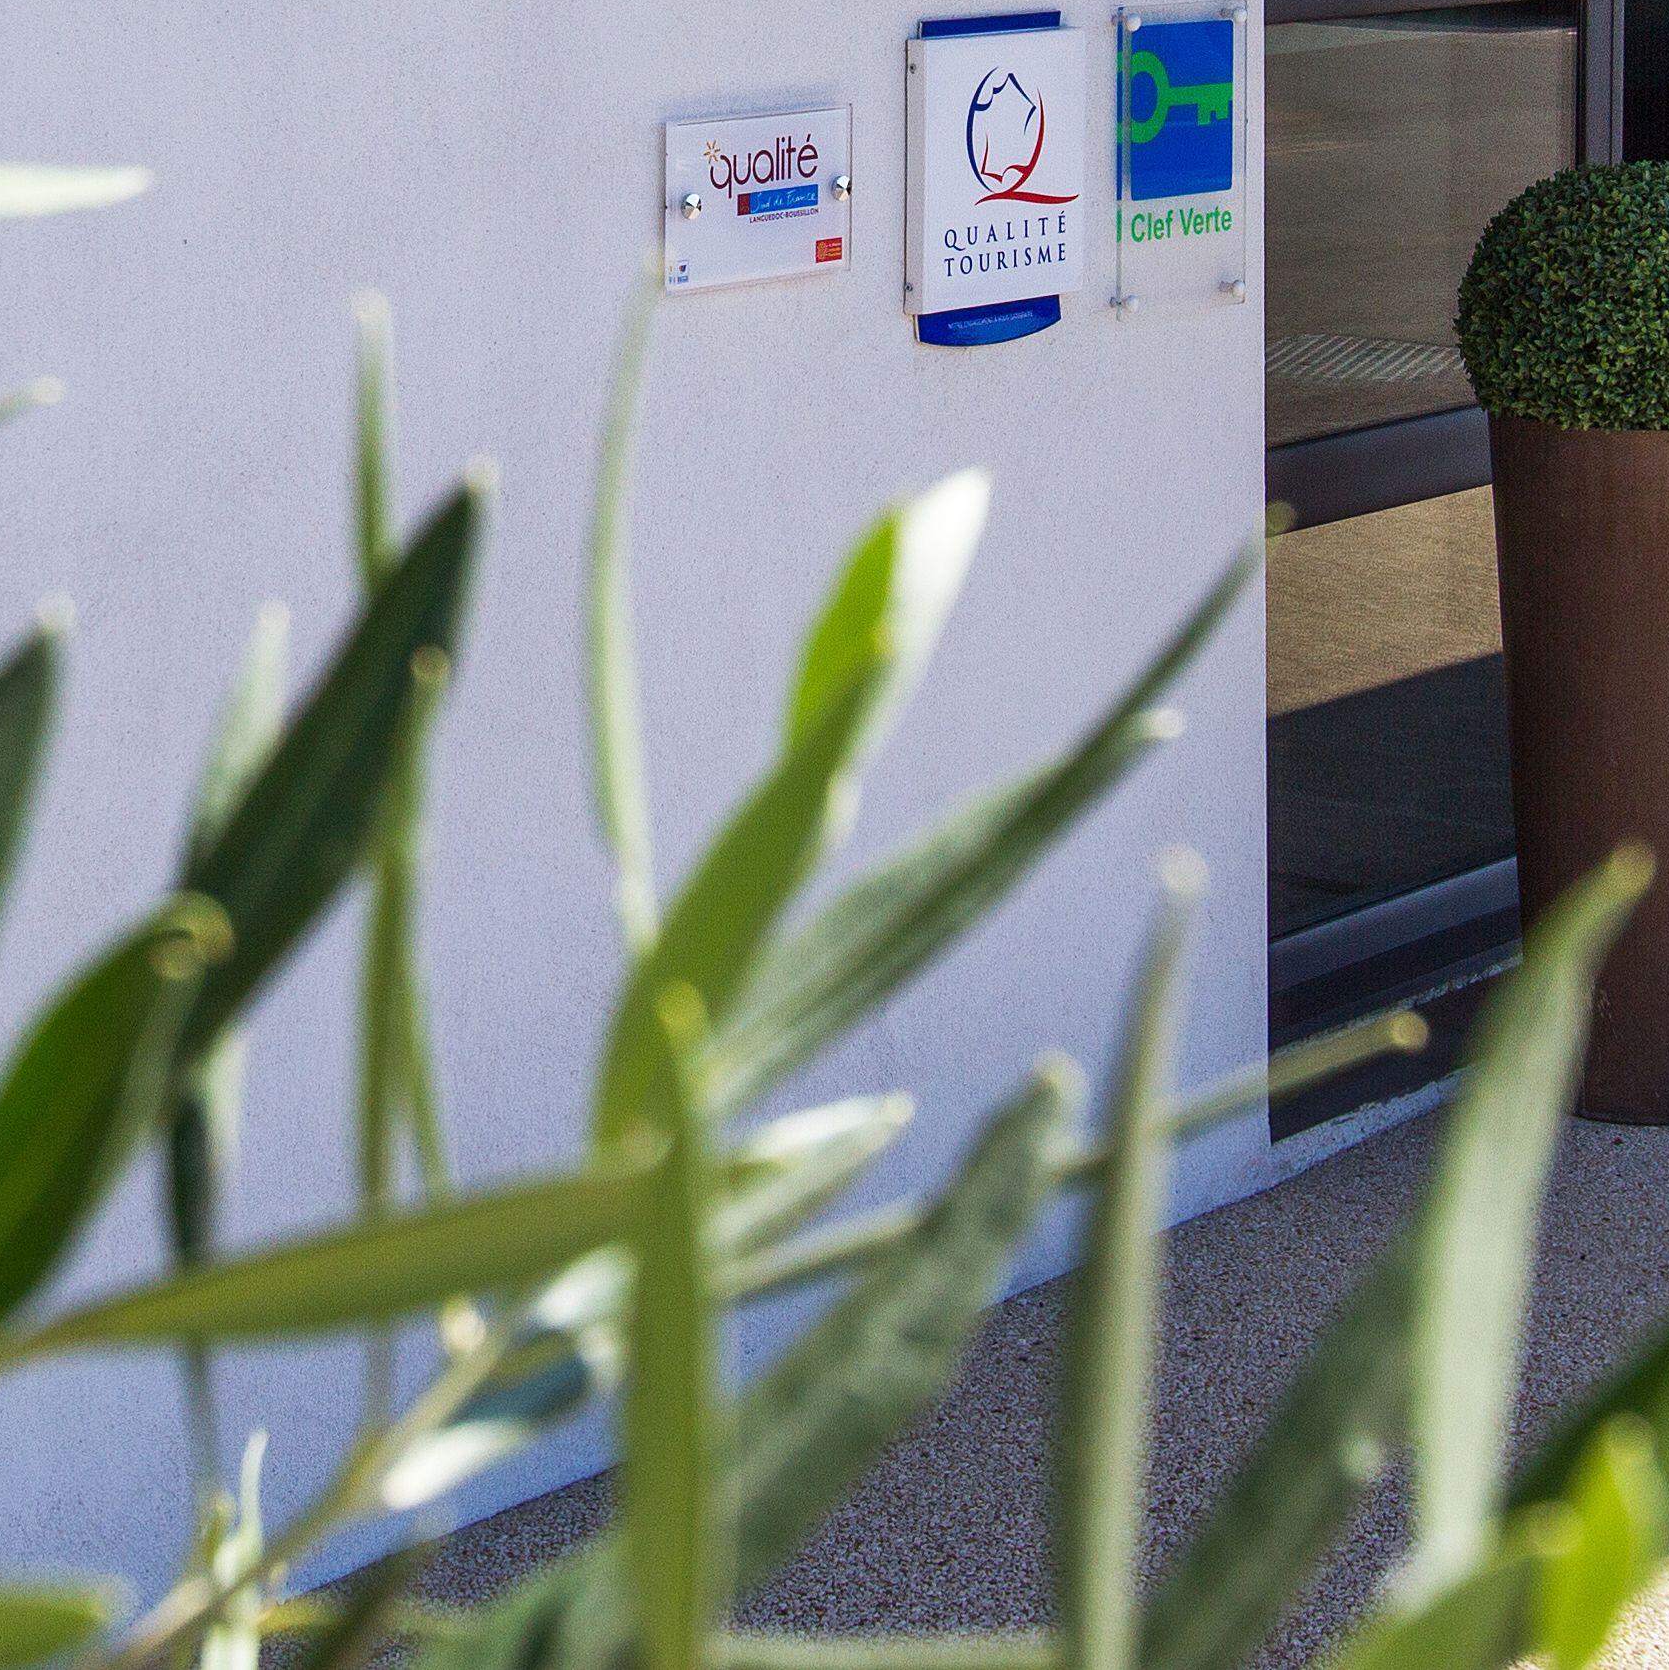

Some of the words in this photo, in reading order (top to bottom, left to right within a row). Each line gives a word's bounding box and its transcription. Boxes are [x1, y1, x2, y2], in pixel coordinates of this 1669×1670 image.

[709, 133, 819, 199] qualité
[786, 189, 818, 207] France
[944, 210, 1067, 252] QUALITÉ
[1130, 209, 1174, 243] Clef
[1179, 205, 1233, 236] Verte
[944, 242, 1067, 277] TOURISME
